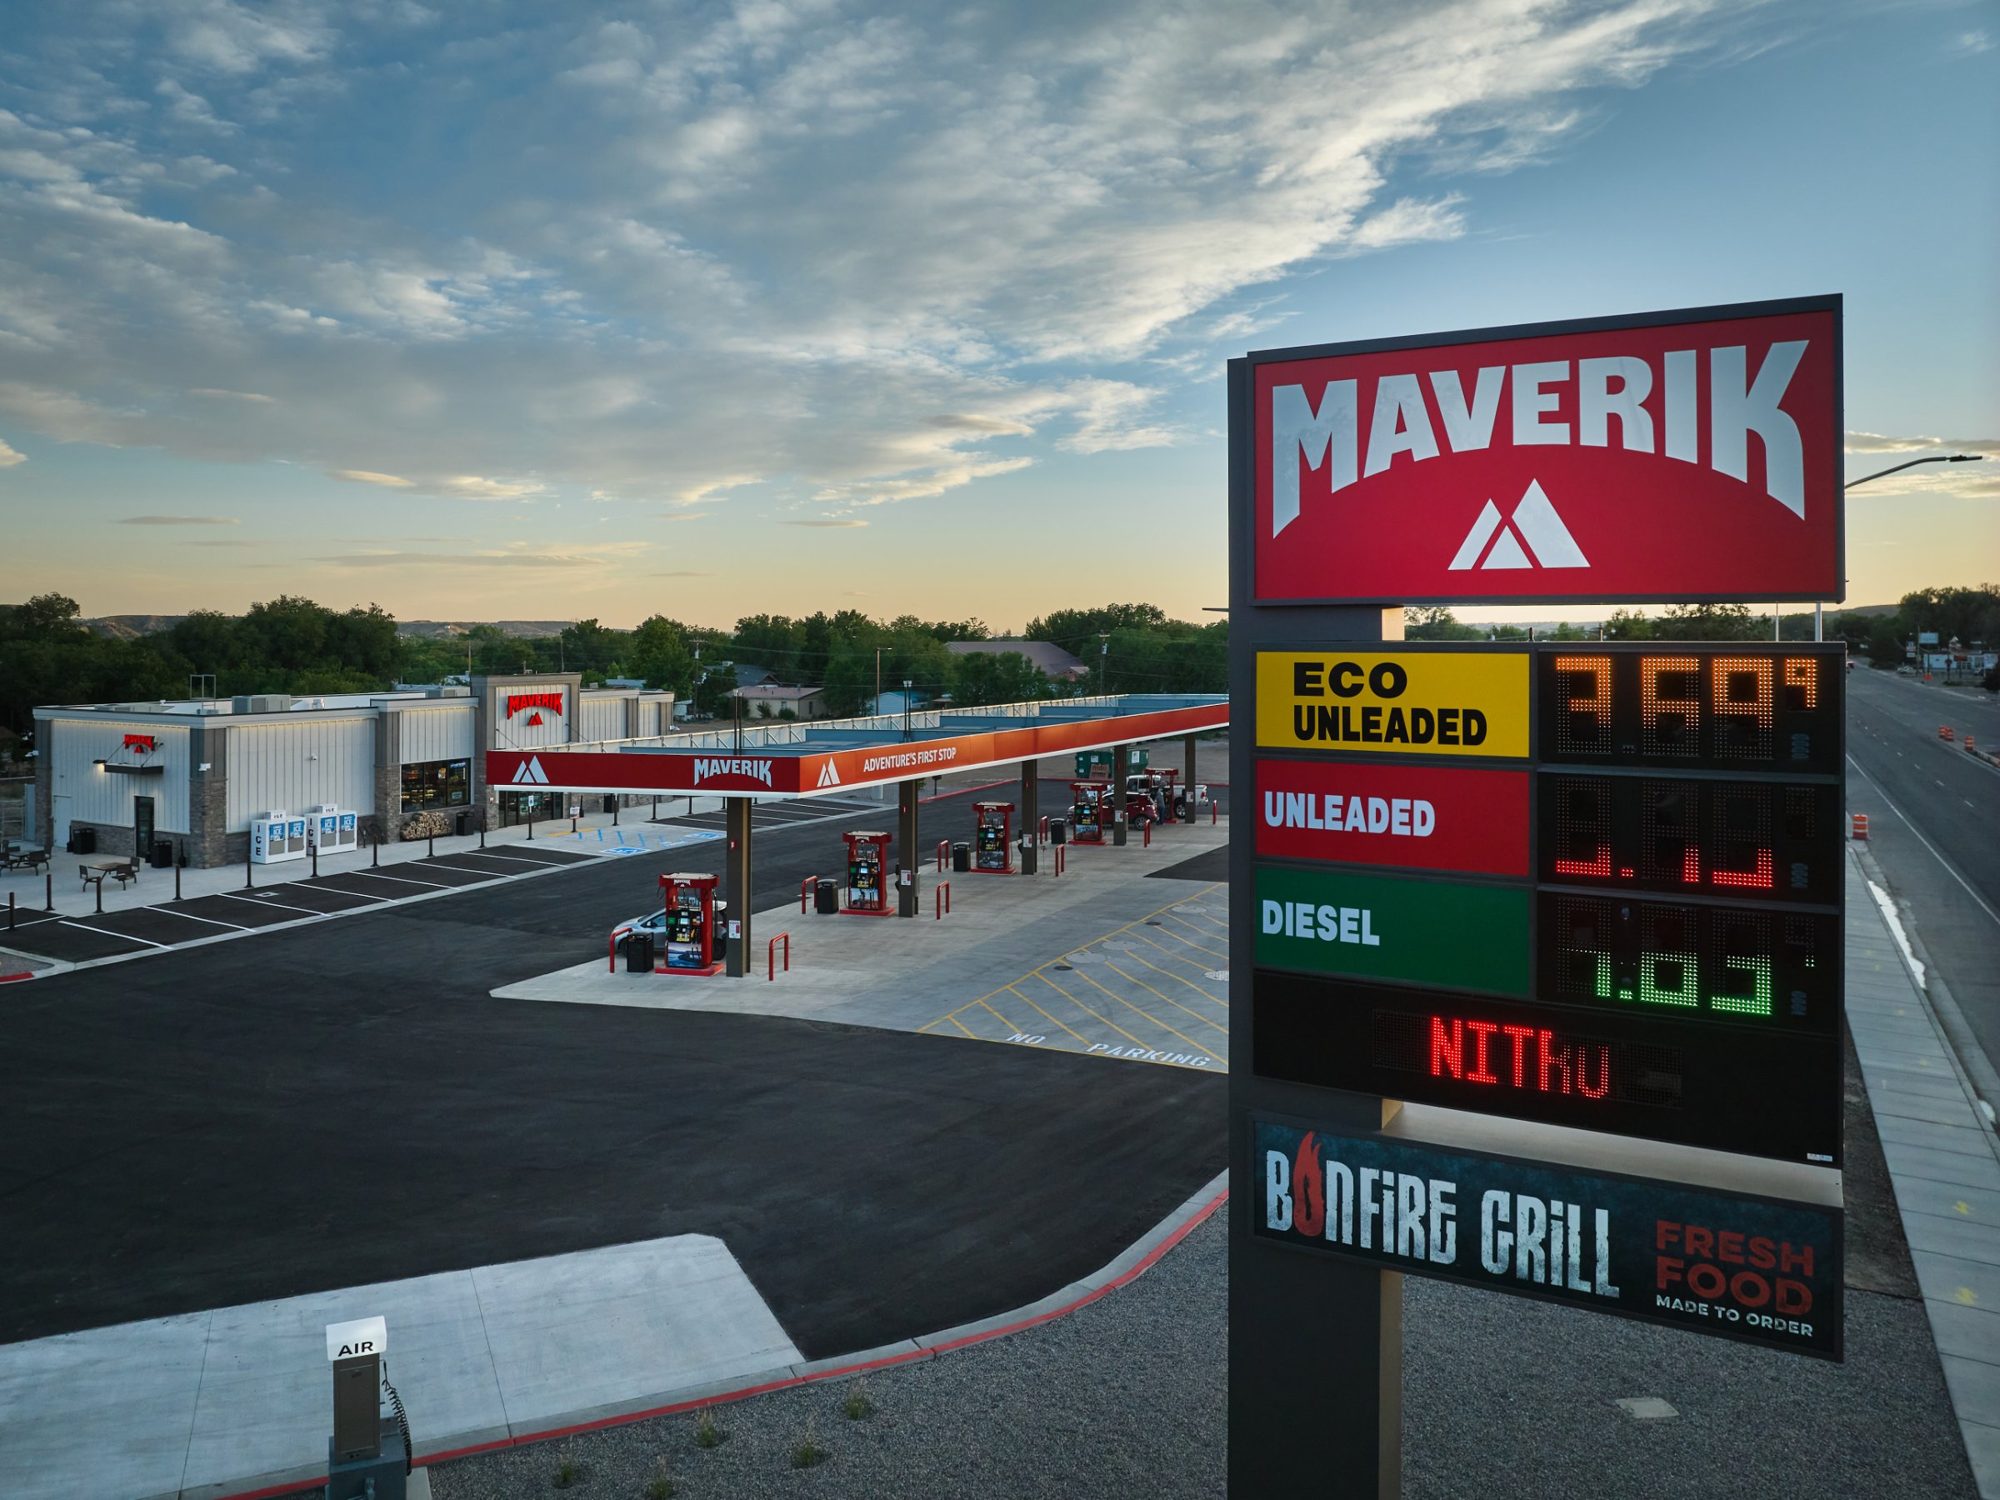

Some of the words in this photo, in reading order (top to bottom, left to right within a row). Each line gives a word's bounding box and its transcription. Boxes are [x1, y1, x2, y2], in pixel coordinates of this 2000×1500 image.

[1273, 340, 1810, 539] MAVERIK
[1294, 662, 1407, 699] ECO
[507, 693, 563, 720] MAVERIK
[1294, 705, 1487, 746] UNLEADED
[694, 758, 772, 788] MAVERIK
[863, 752, 917, 772] ADVENTURE'S
[917, 749, 938, 764] FIRST
[938, 747, 957, 761] STOP
[1264, 791, 1436, 837] UNLEADED
[1262, 900, 1380, 945] DIESEL
[1006, 1032, 1046, 1045] NO
[1086, 1043, 1210, 1067] PARKING
[1481, 1190, 1620, 1298] GRILL
[1656, 1219, 1814, 1277] FRESH
[1656, 1255, 1813, 1316] FOOD
[1656, 1294, 1709, 1316] MADE
[1714, 1306, 1740, 1321] TO
[1746, 1312, 1813, 1337] ORDER
[338, 1341, 374, 1357] AIR
